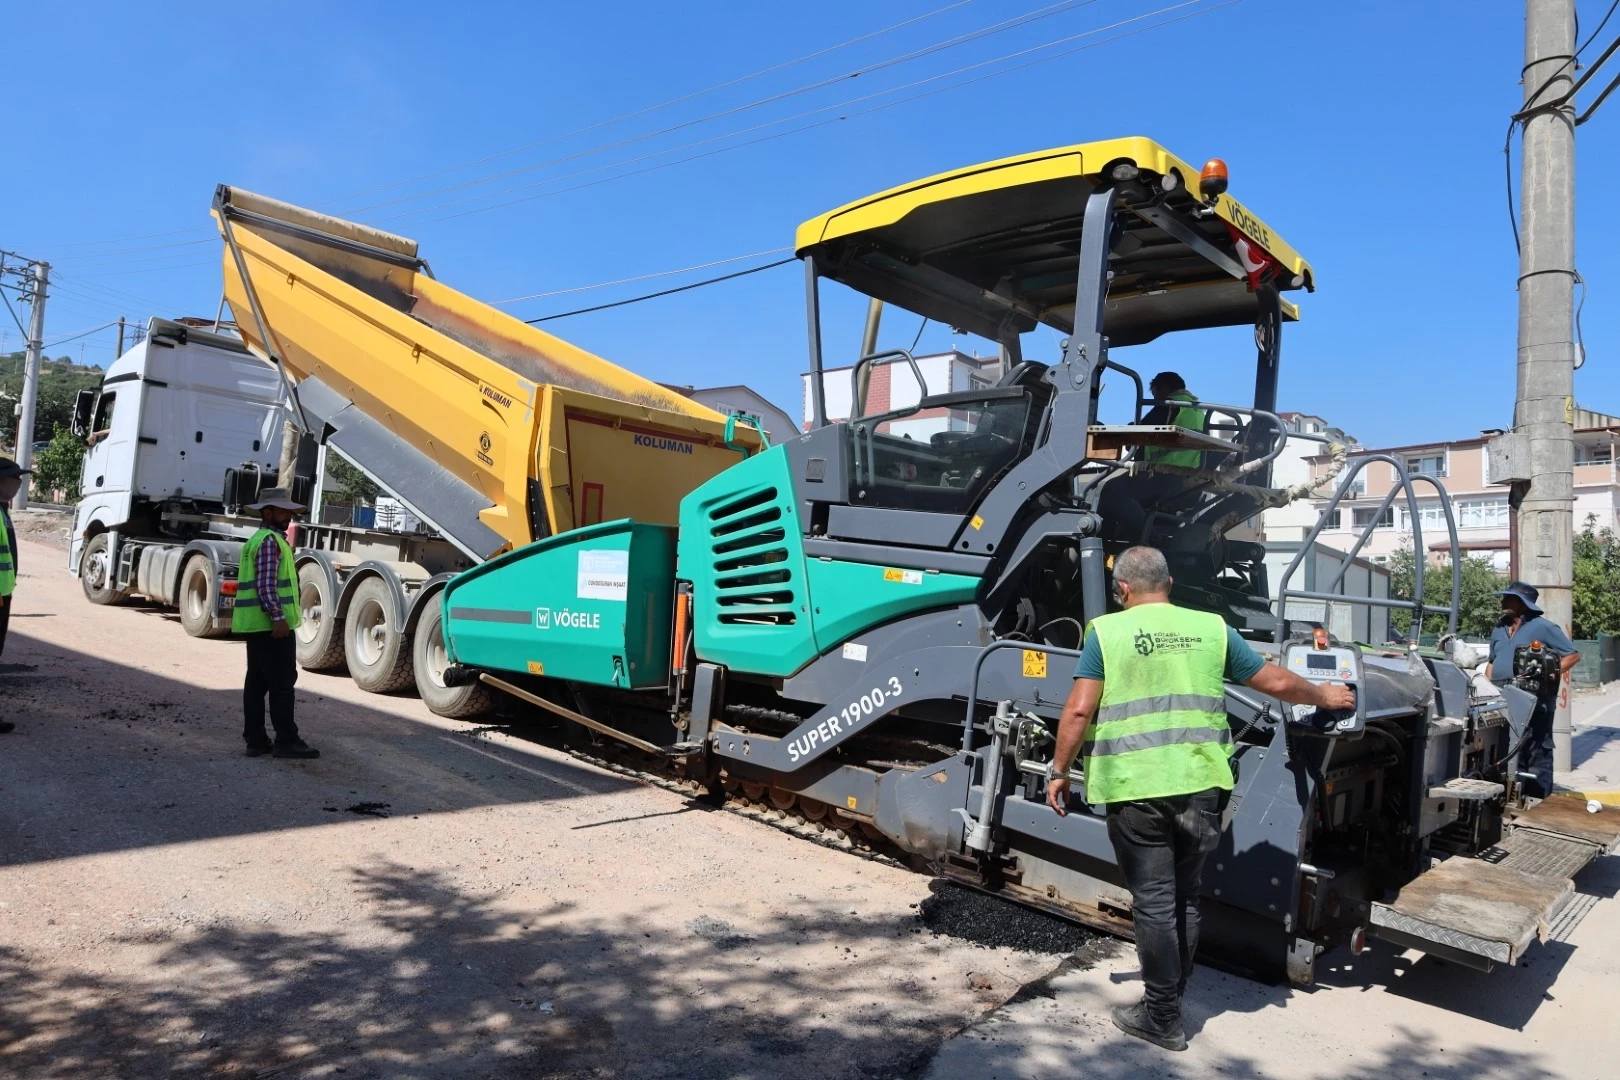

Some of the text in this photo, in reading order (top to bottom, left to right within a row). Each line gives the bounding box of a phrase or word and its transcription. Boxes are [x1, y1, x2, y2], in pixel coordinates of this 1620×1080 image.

[1226, 200, 1271, 250] VÖGELE
[483, 386, 512, 409] KOLUMAN
[634, 434, 693, 455] KOLUMAN
[553, 608, 601, 629] VÖGELE
[787, 676, 903, 762] SUPER 1900-3
